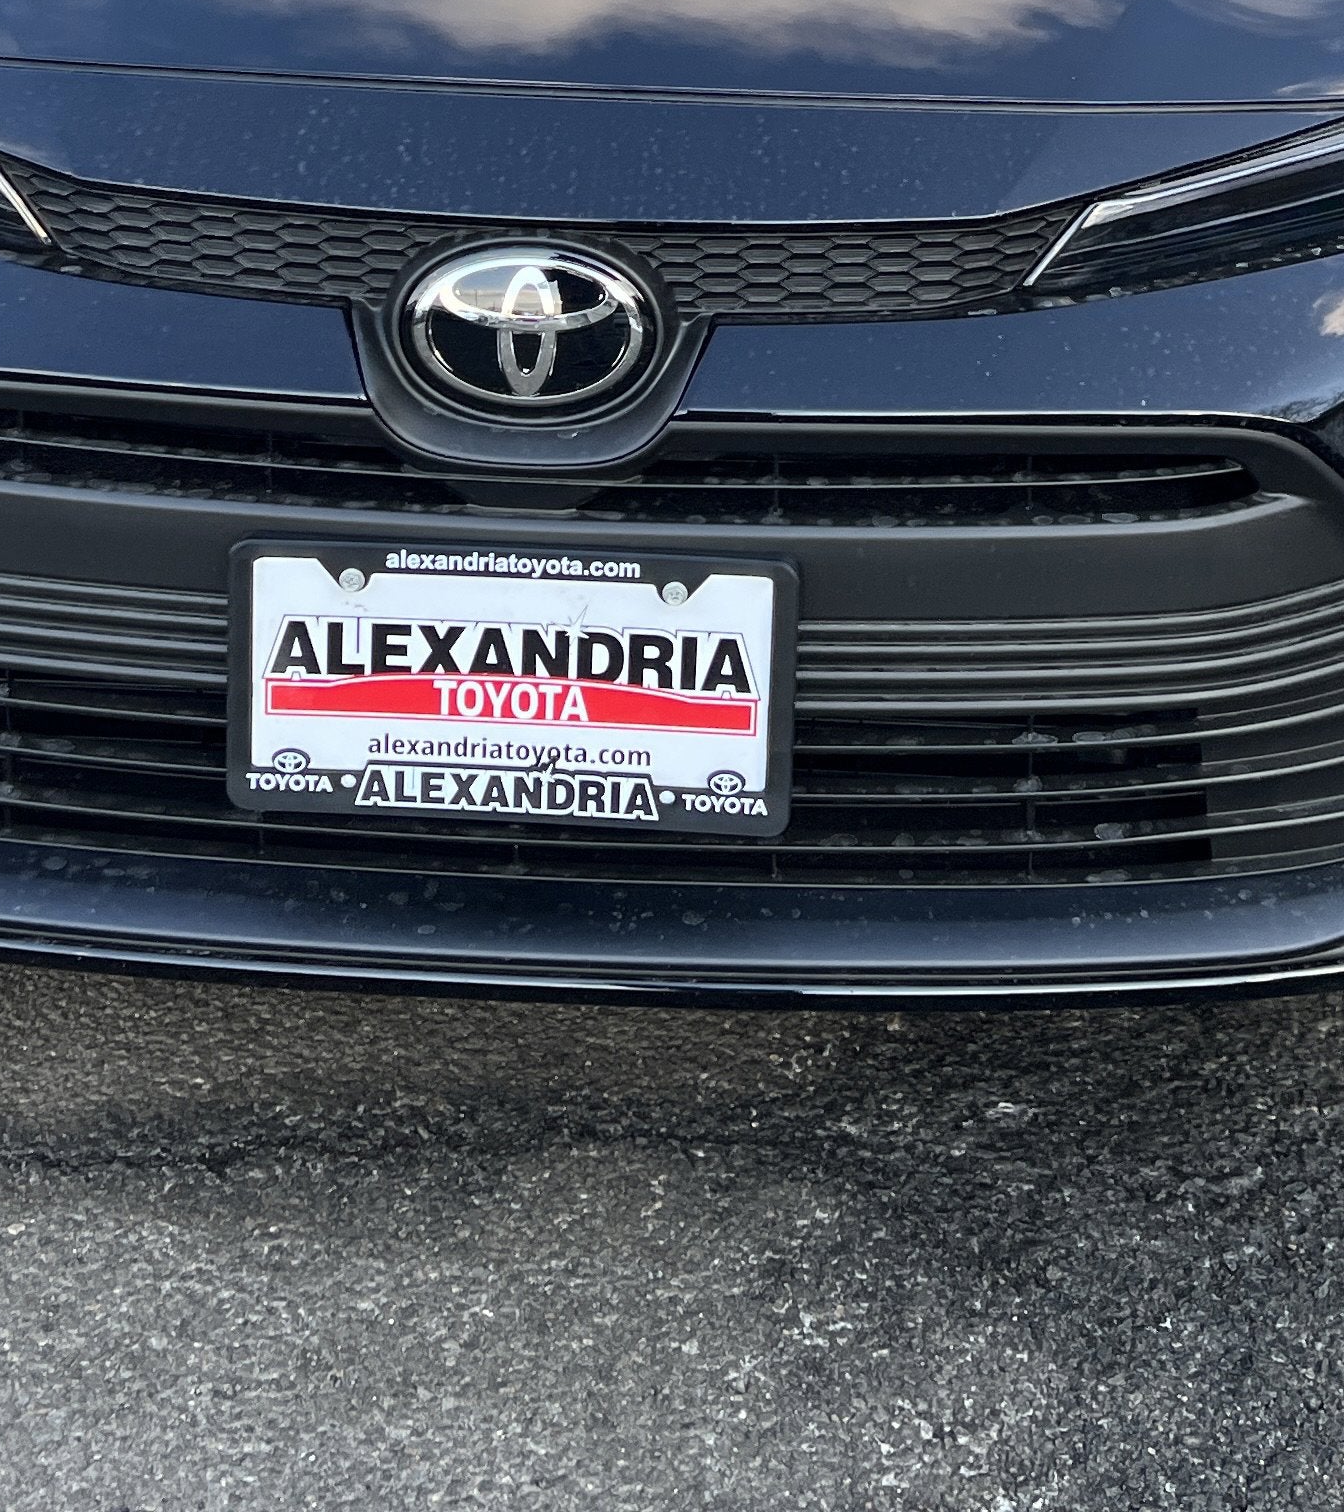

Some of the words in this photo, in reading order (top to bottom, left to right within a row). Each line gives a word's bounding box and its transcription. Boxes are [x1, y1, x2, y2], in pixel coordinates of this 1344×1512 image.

[385, 550, 641, 580] alexandriatoyota.com
[269, 620, 754, 695] ALEXANDRIA
[433, 679, 588, 722] TOYOTA
[368, 733, 652, 768] alexandriatoyota.com
[246, 772, 333, 794] TOYOTA
[356, 762, 659, 820] ALEXANDRIA
[681, 792, 768, 816] TOYOTA
